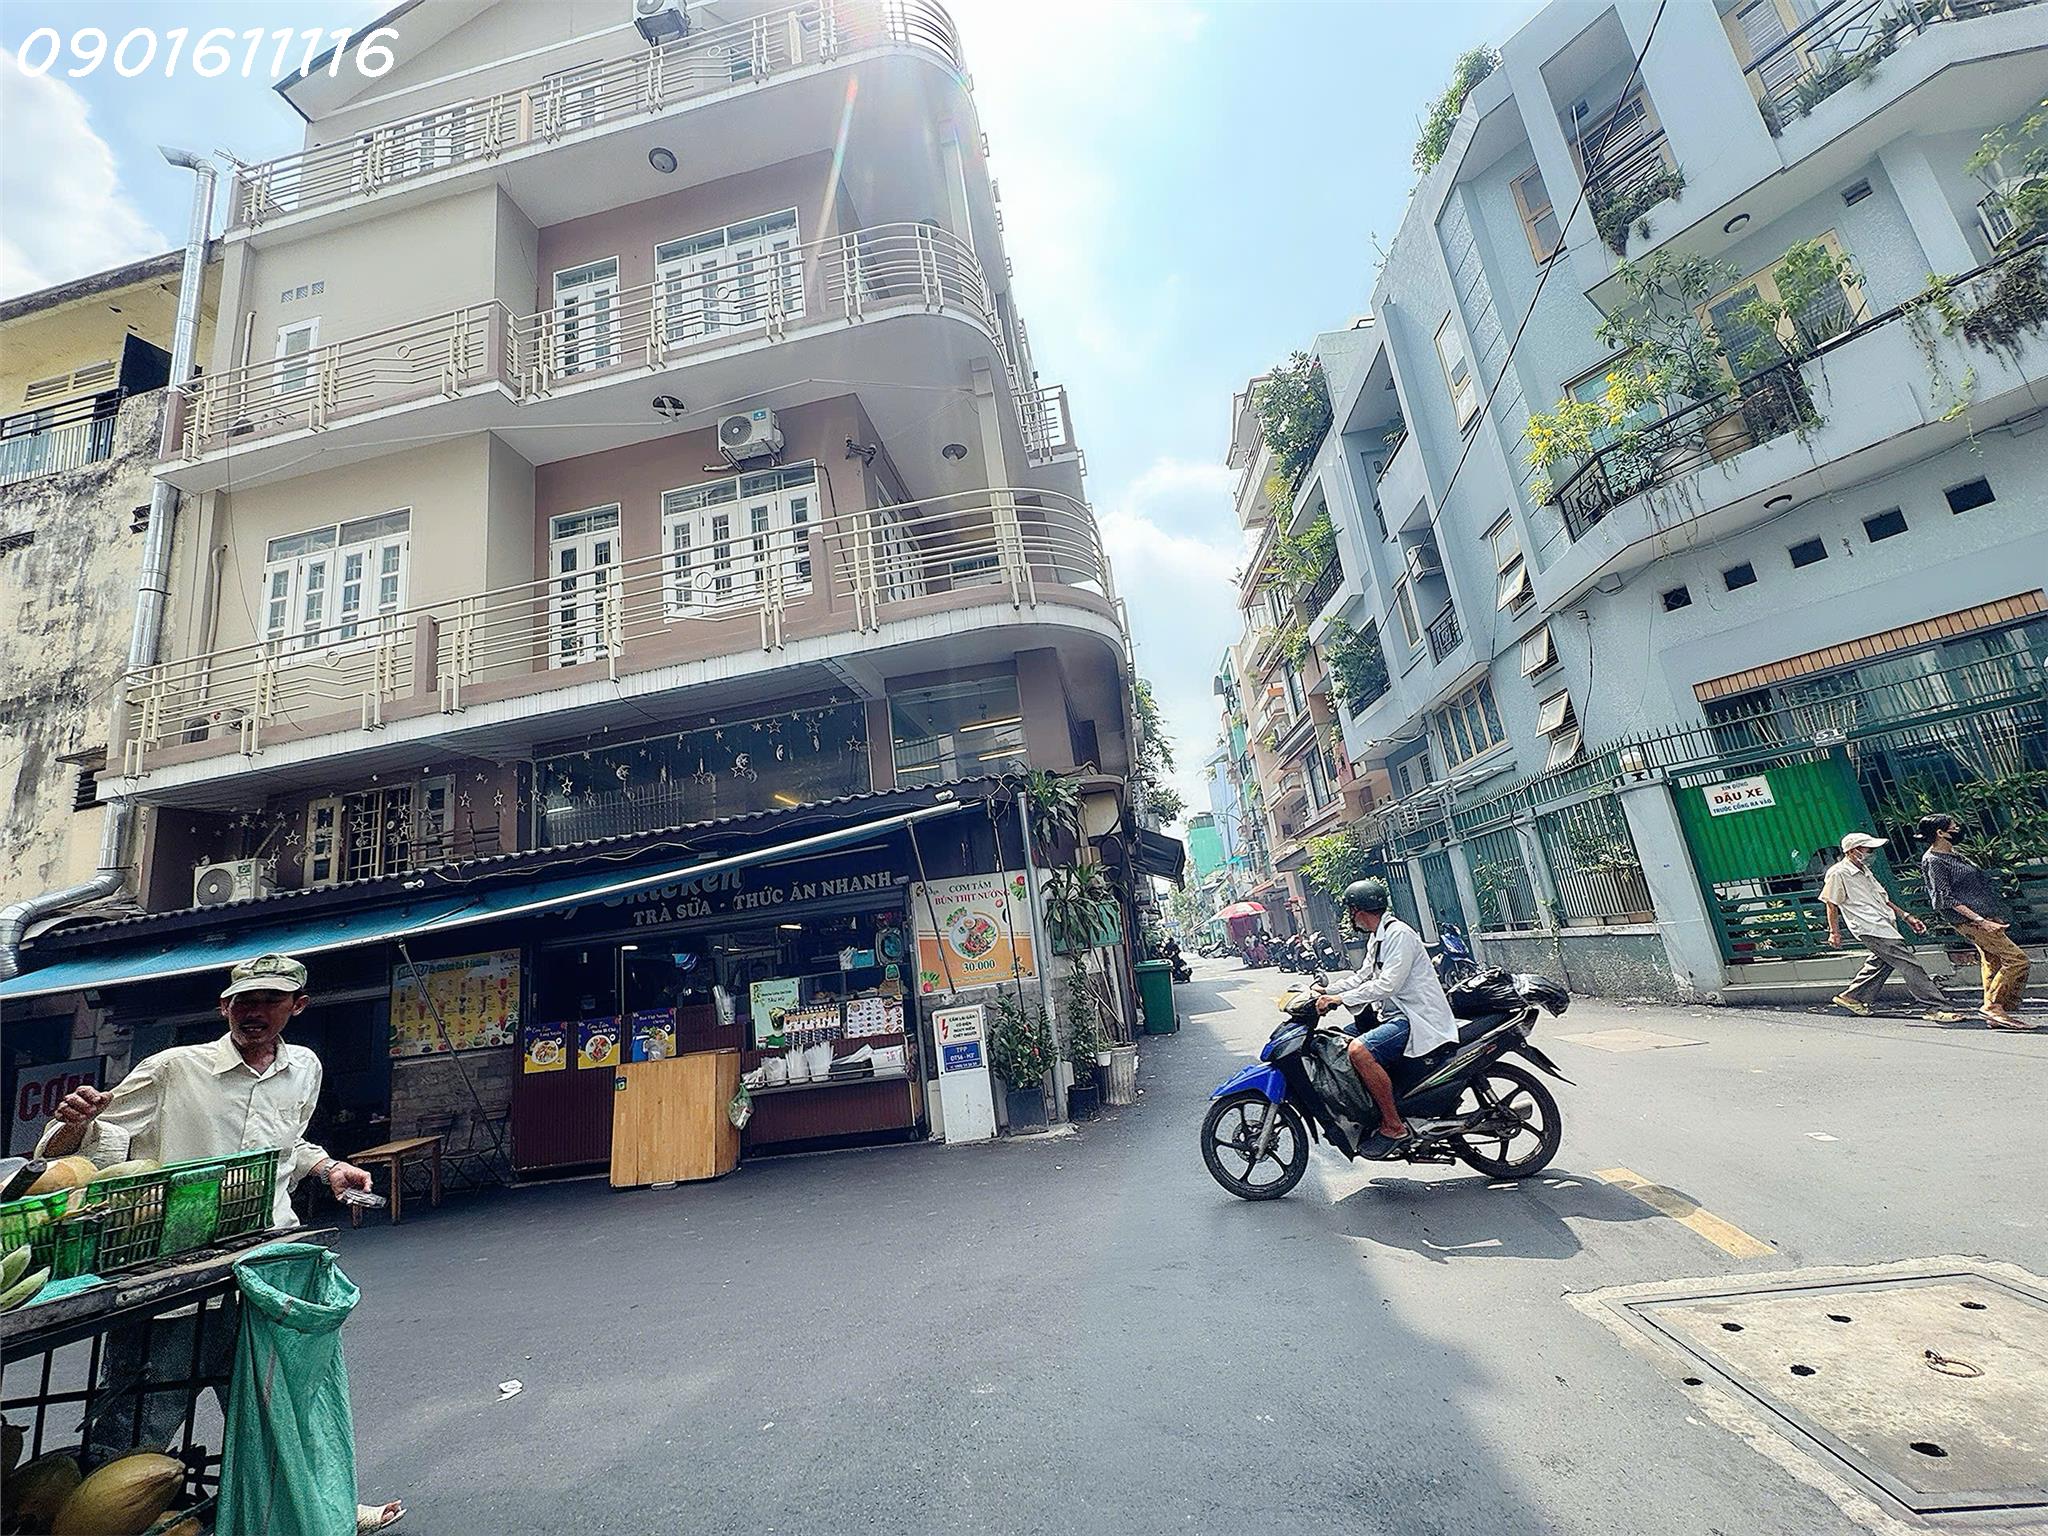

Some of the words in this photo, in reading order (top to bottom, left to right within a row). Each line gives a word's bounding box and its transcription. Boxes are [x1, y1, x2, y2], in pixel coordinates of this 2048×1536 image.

[1714, 790, 1742, 804] ĐẬU
[1746, 788, 1763, 798] XE
[633, 902, 673, 927] TRÀ
[676, 896, 713, 919] SỮA
[734, 886, 784, 911] THỨC
[789, 881, 816, 902] ĂN
[820, 871, 892, 896] NHANH
[962, 959, 996, 973] 30.000
